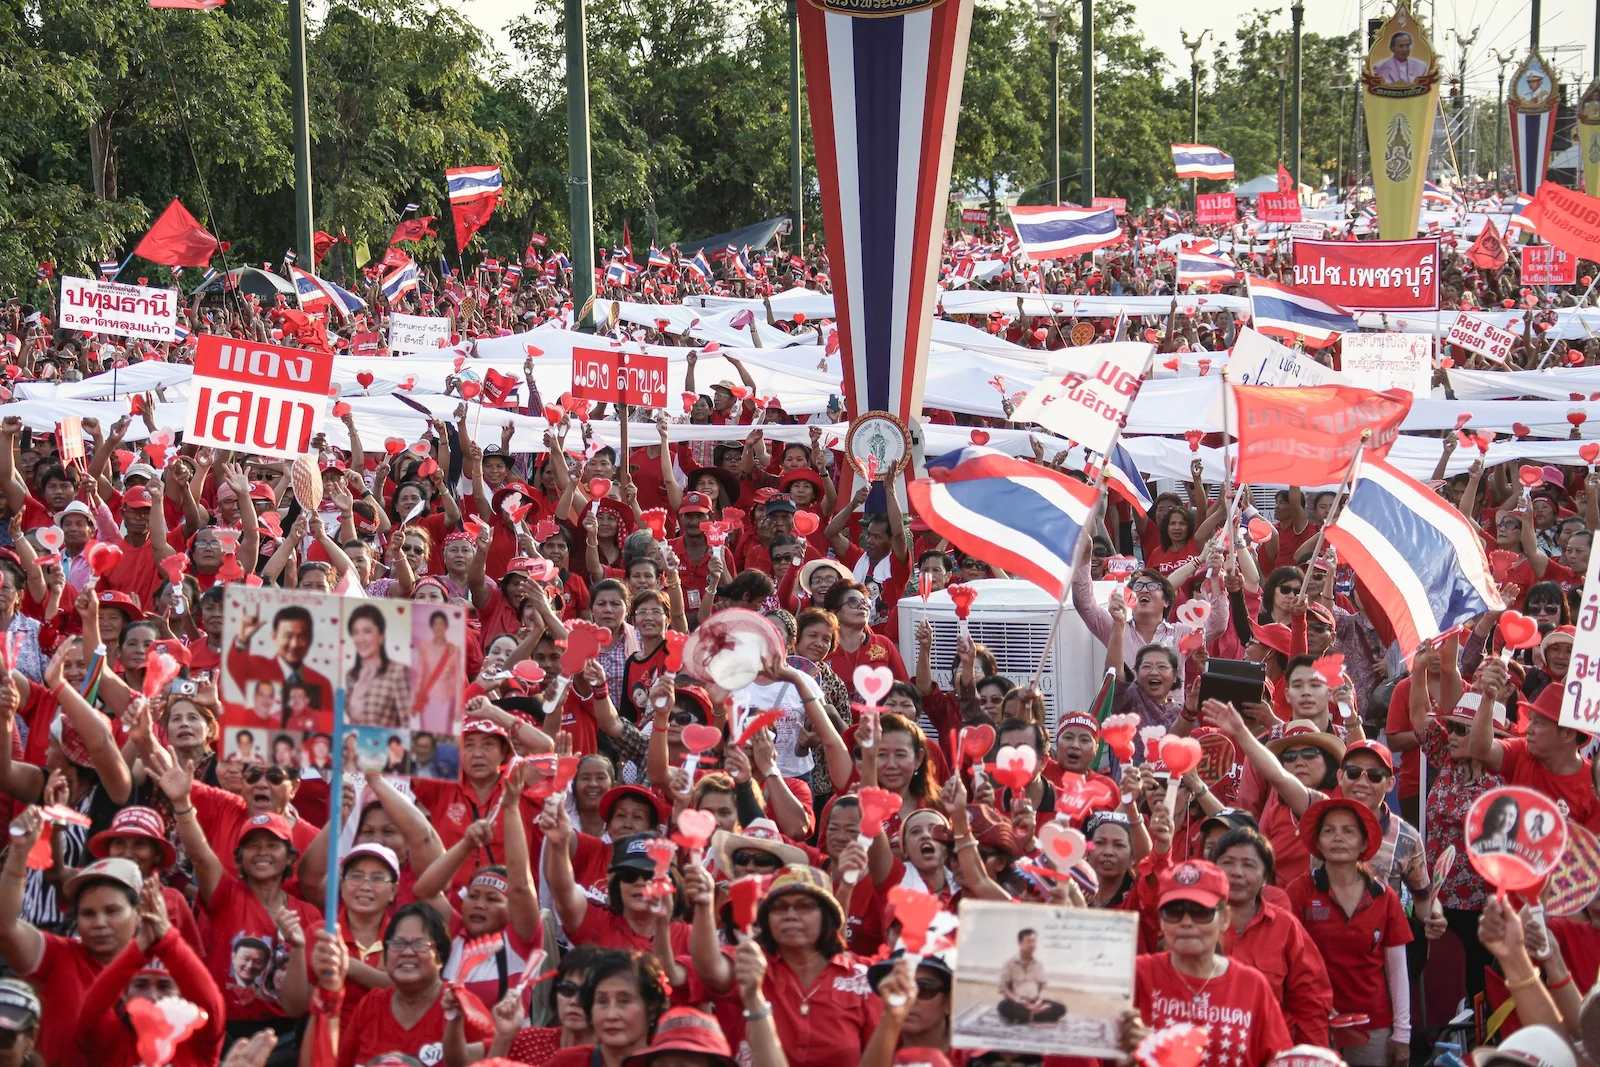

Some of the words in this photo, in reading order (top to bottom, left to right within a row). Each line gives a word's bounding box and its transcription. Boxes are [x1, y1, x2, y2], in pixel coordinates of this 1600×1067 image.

[1293, 254, 1434, 298] นปช.เพชรบุรี
[66, 287, 170, 318] ปทุมธานี
[65, 314, 170, 335] อ.ลาดหลุมแก้ว
[1456, 314, 1482, 332] Red
[1484, 326, 1511, 346] Sure
[1452, 329, 1486, 350] อยุธยา
[1490, 344, 1506, 357] 49
[218, 344, 312, 382] แดง
[574, 360, 608, 390] แดง
[617, 354, 666, 406] ลำพูน
[194, 388, 315, 452] เสนา
